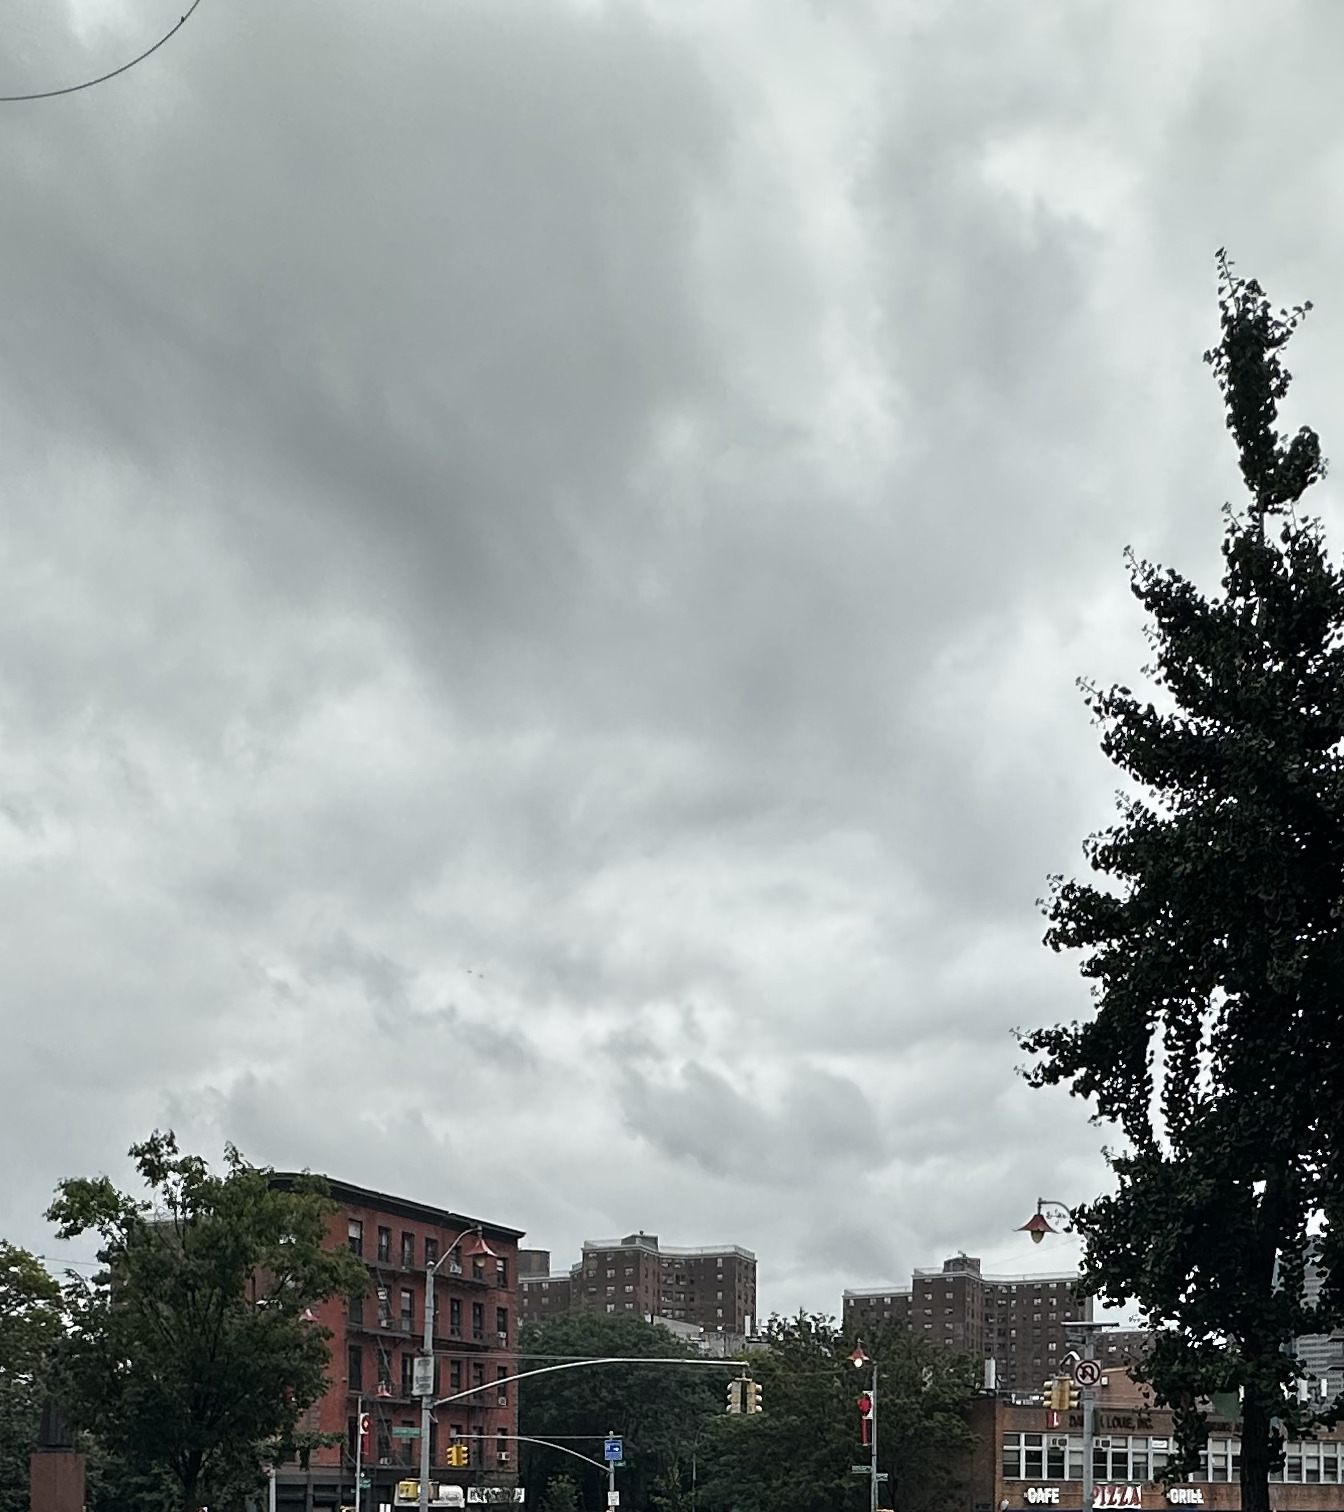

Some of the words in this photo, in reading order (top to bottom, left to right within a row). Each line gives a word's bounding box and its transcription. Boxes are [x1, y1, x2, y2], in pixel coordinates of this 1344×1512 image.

[1027, 1487, 1060, 1504] CAFE
[1092, 1484, 1141, 1507] PIZZA
[1170, 1488, 1205, 1505] GRILL
